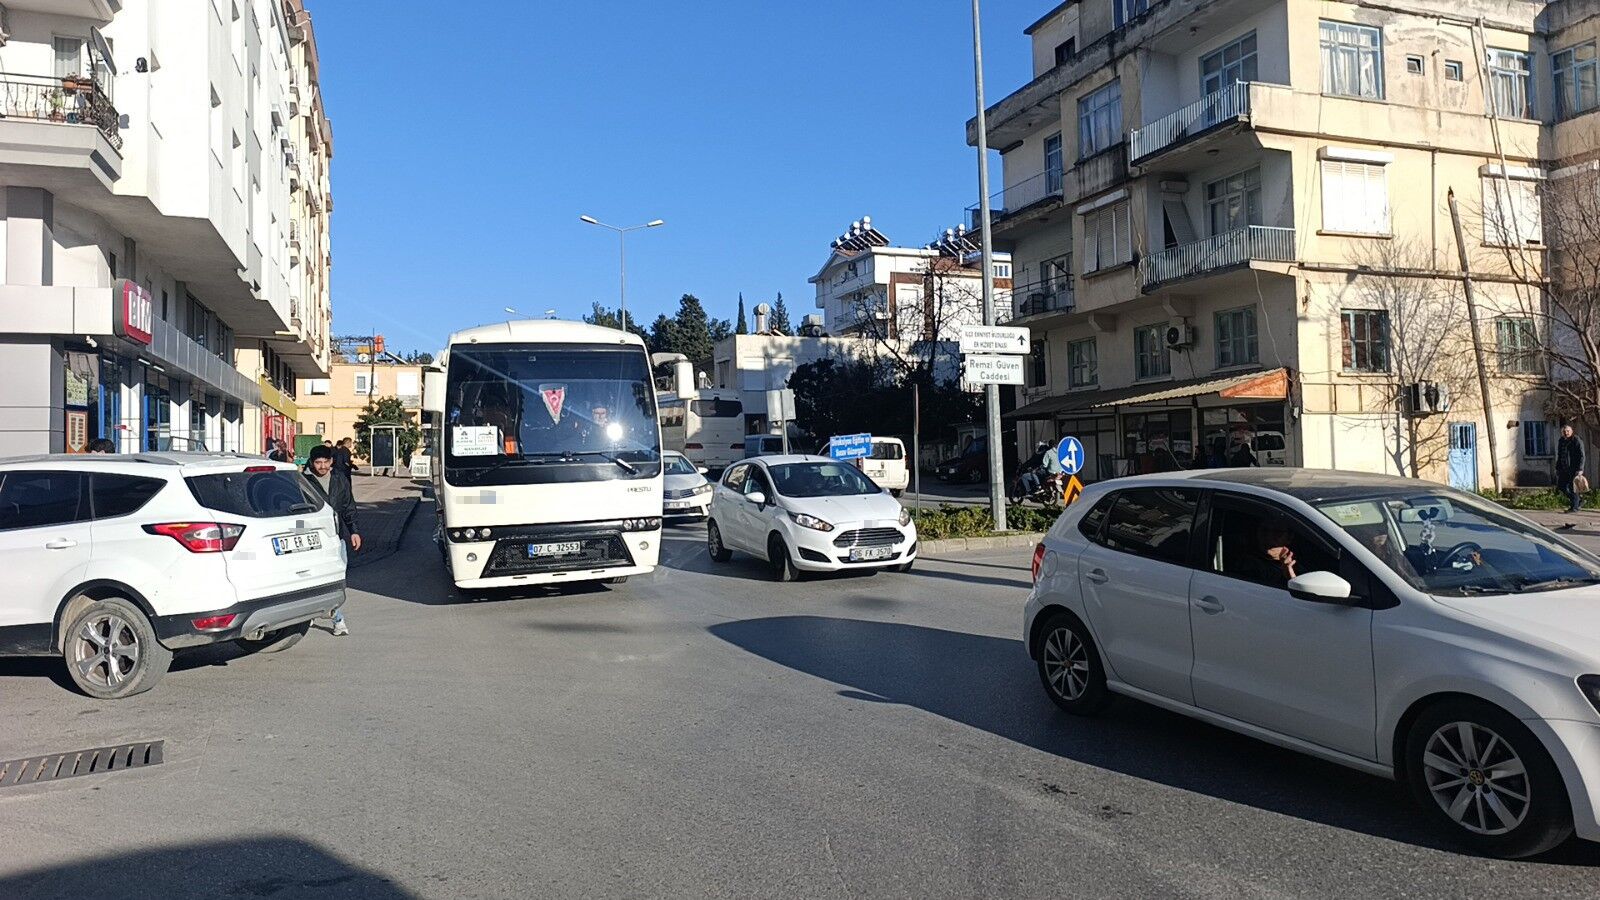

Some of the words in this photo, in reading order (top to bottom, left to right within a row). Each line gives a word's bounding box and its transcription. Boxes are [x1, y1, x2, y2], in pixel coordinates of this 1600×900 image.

[970, 359, 993, 369] Remzi
[996, 360, 1020, 370] Güven
[980, 371, 1010, 381] Caddesi
[280, 538, 289, 550] 07
[294, 536, 304, 548] ER
[307, 534, 321, 546] 630
[533, 545, 543, 553] 07
[547, 544, 552, 552] C
[556, 543, 580, 552] 32553
